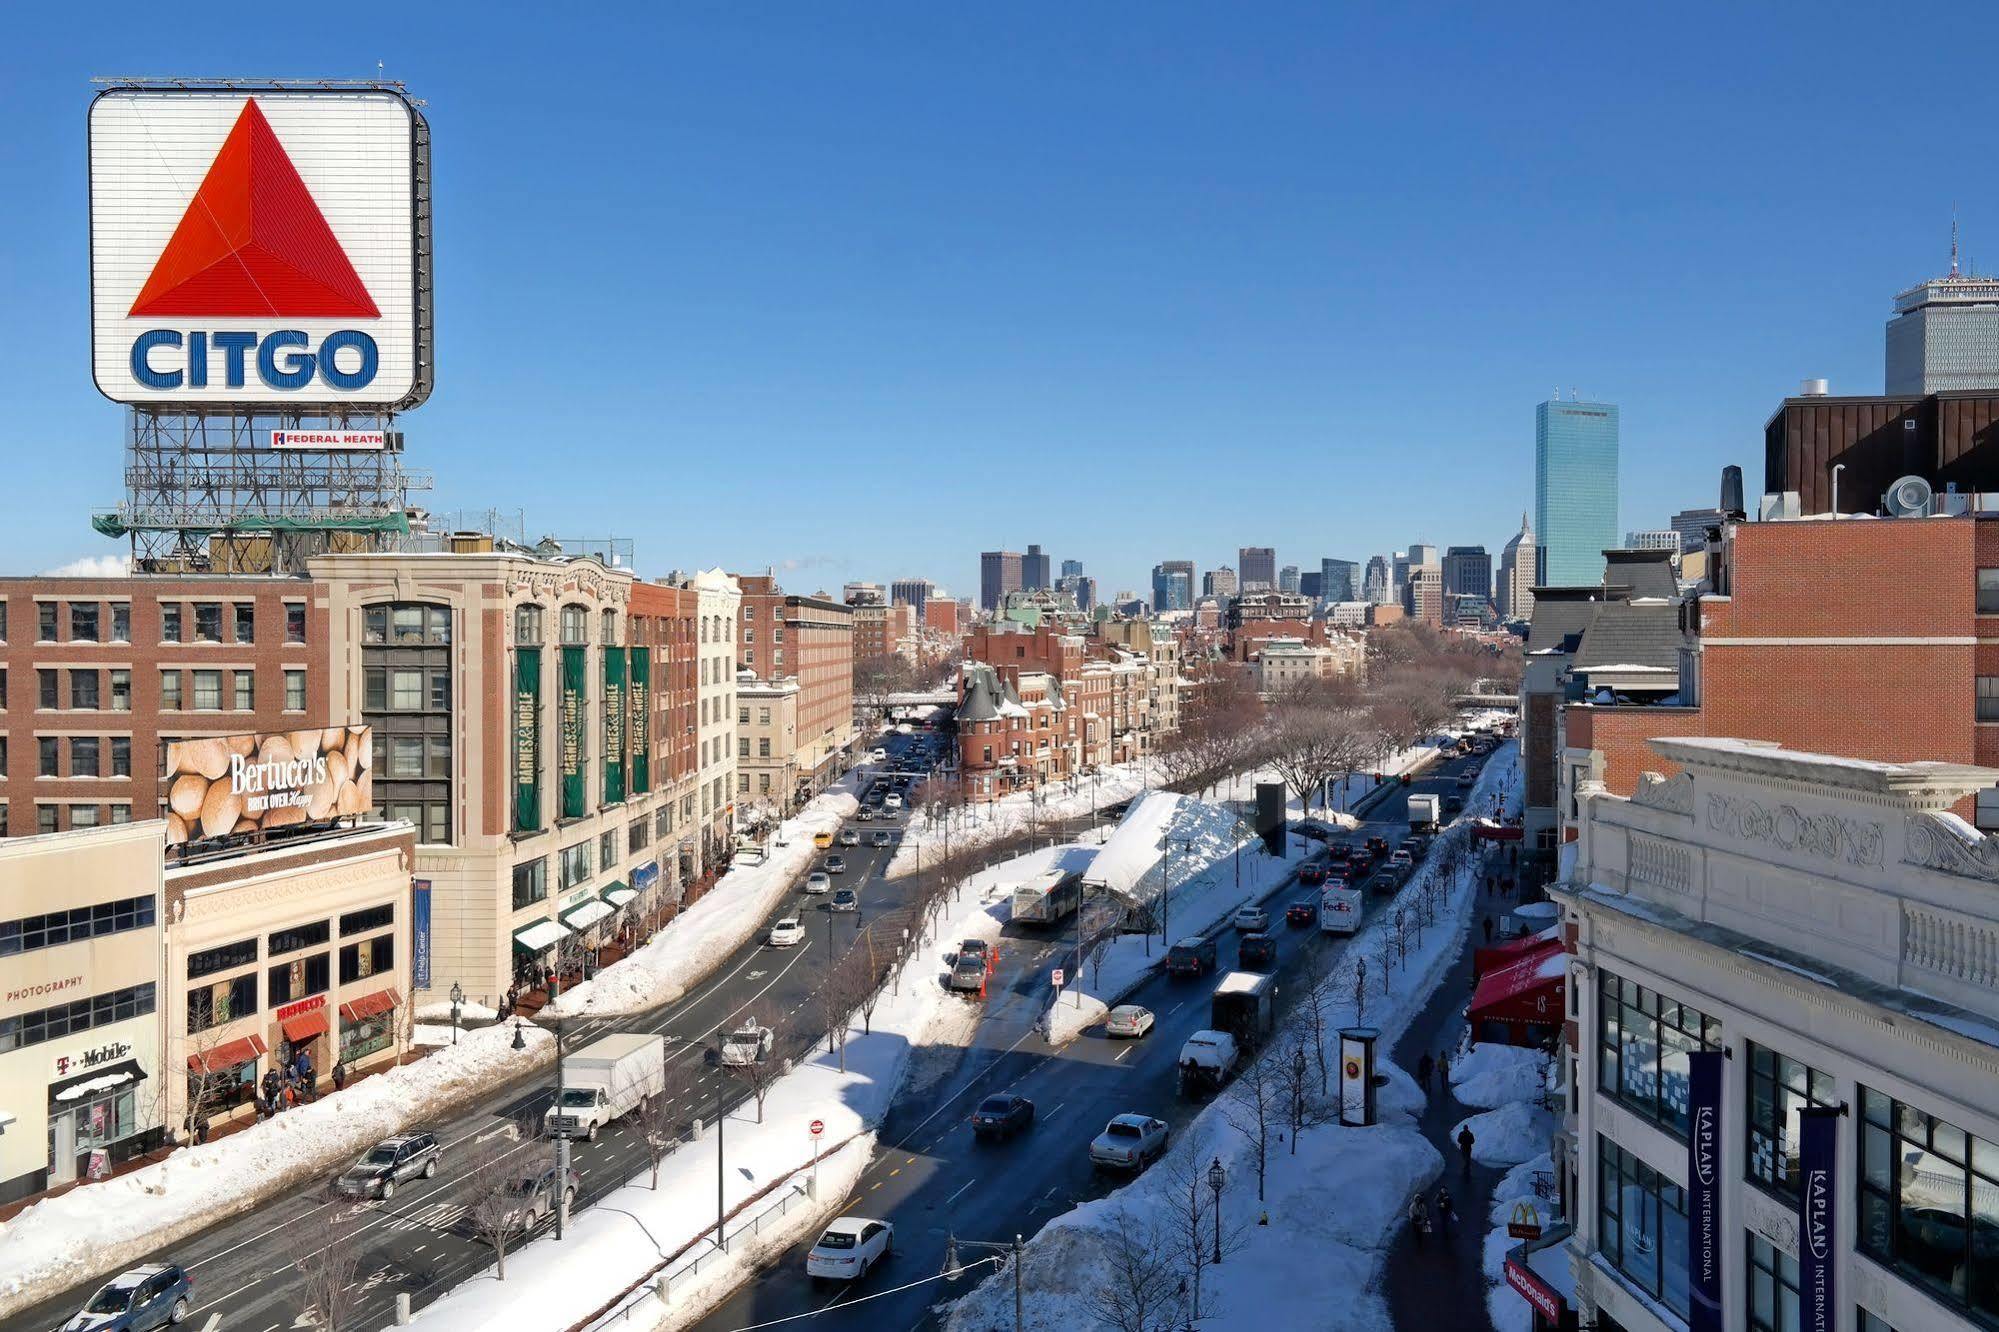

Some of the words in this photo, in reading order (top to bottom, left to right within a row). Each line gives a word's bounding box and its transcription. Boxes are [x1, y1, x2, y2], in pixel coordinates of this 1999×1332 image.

[129, 329, 379, 392] CITGO
[286, 435, 339, 443] FEDERAL
[343, 435, 383, 443] HEATH
[230, 749, 327, 795] Bertucci's
[269, 792, 289, 809] OVEN
[1323, 901, 1352, 912] FedEx
[418, 931, 426, 954] Center
[418, 955, 426, 972] Help
[7, 975, 83, 1001] PHOTOGRAPHY
[1701, 1106, 1713, 1176] KAPLAN
[1813, 1170, 1826, 1248] KAPLAN
[1702, 1190, 1712, 1283] INTERNATIONAL
[1508, 1266, 1555, 1317] McDonald's
